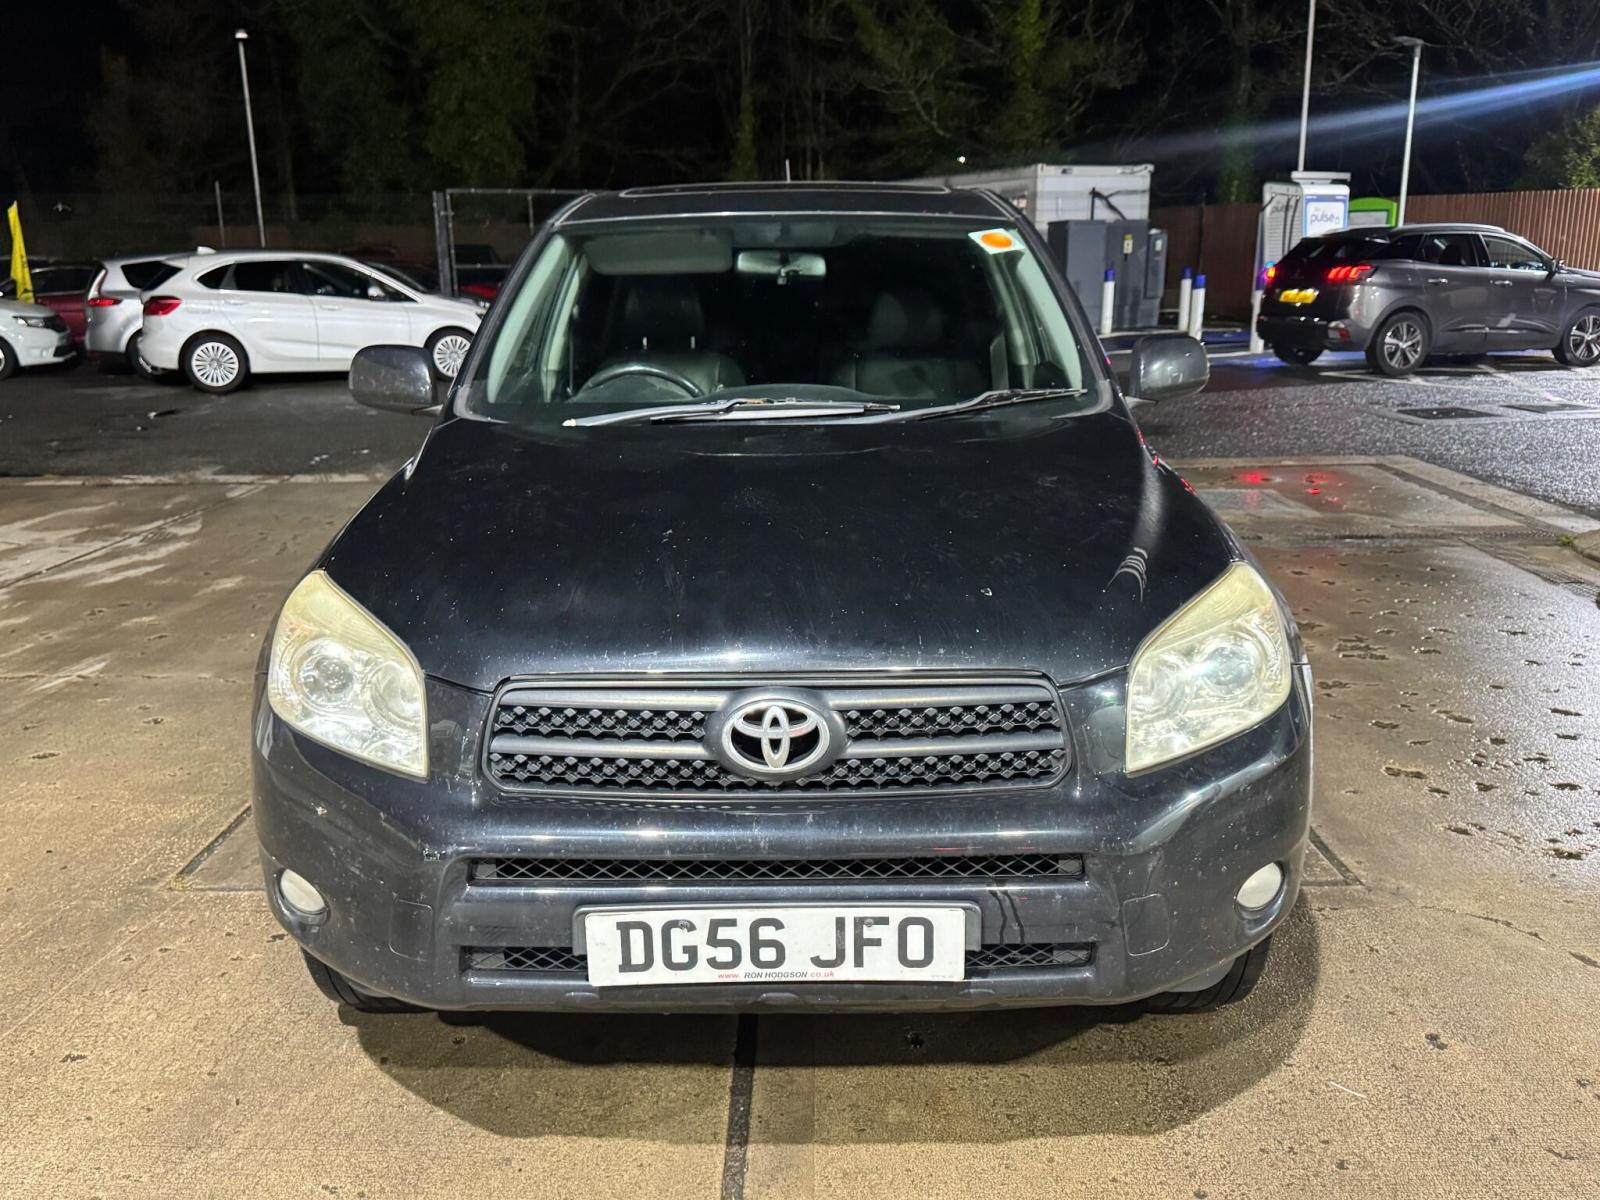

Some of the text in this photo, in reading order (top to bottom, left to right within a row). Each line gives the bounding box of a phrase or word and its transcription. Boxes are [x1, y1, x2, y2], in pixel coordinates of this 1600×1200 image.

[1310, 209, 1335, 225] pulse
[616, 916, 935, 973] DG56 JFO
